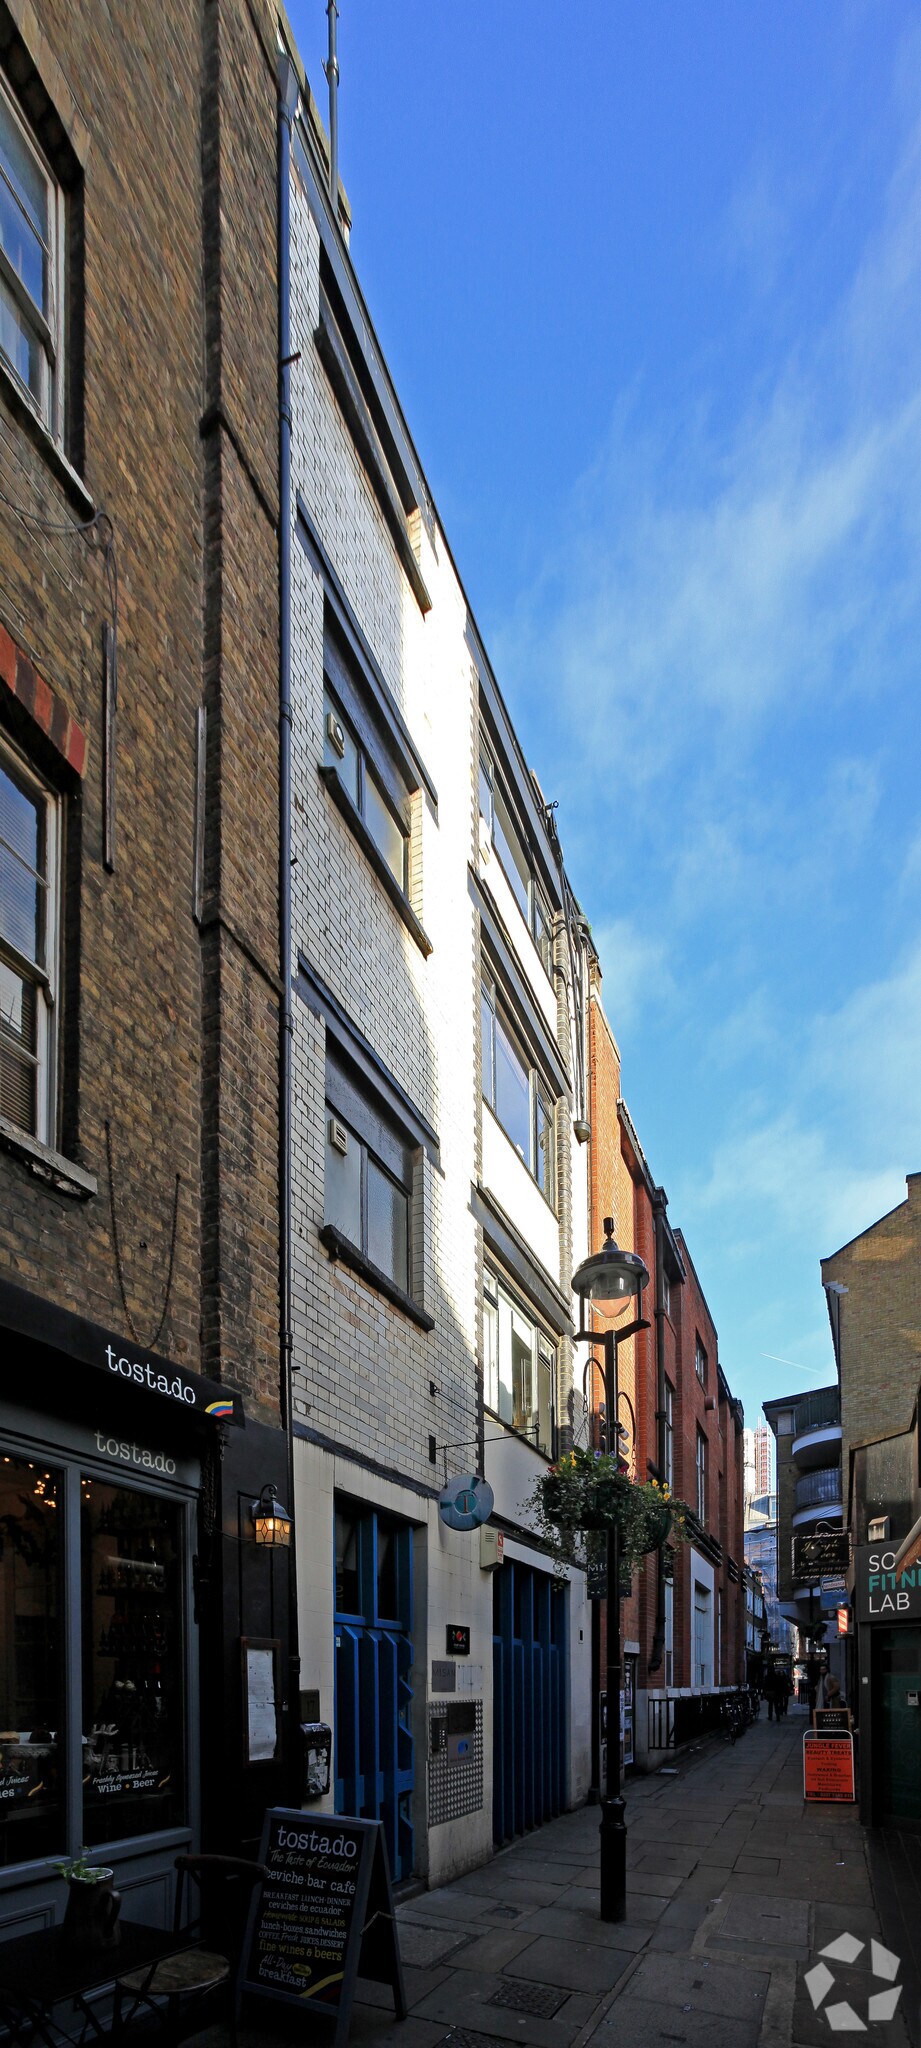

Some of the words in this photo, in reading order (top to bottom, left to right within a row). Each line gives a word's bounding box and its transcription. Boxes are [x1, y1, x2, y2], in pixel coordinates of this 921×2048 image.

[105, 1344, 196, 1404] tostado
[94, 1428, 176, 1475] tostado
[868, 1592, 911, 1614] LAB
[97, 1782, 122, 1794] Wine
[132, 1779, 155, 1789] Beer
[277, 1825, 357, 1858] tostado
[263, 1891, 299, 1901] BREAKFAST
[330, 1879, 356, 1895] café
[299, 1903, 309, 1912] de
[321, 1918, 346, 1928] SALADS
[259, 1940, 277, 1952] fine
[278, 1944, 306, 1957] wines
[314, 1946, 343, 1961] beers
[258, 1963, 307, 1988] breakfast
